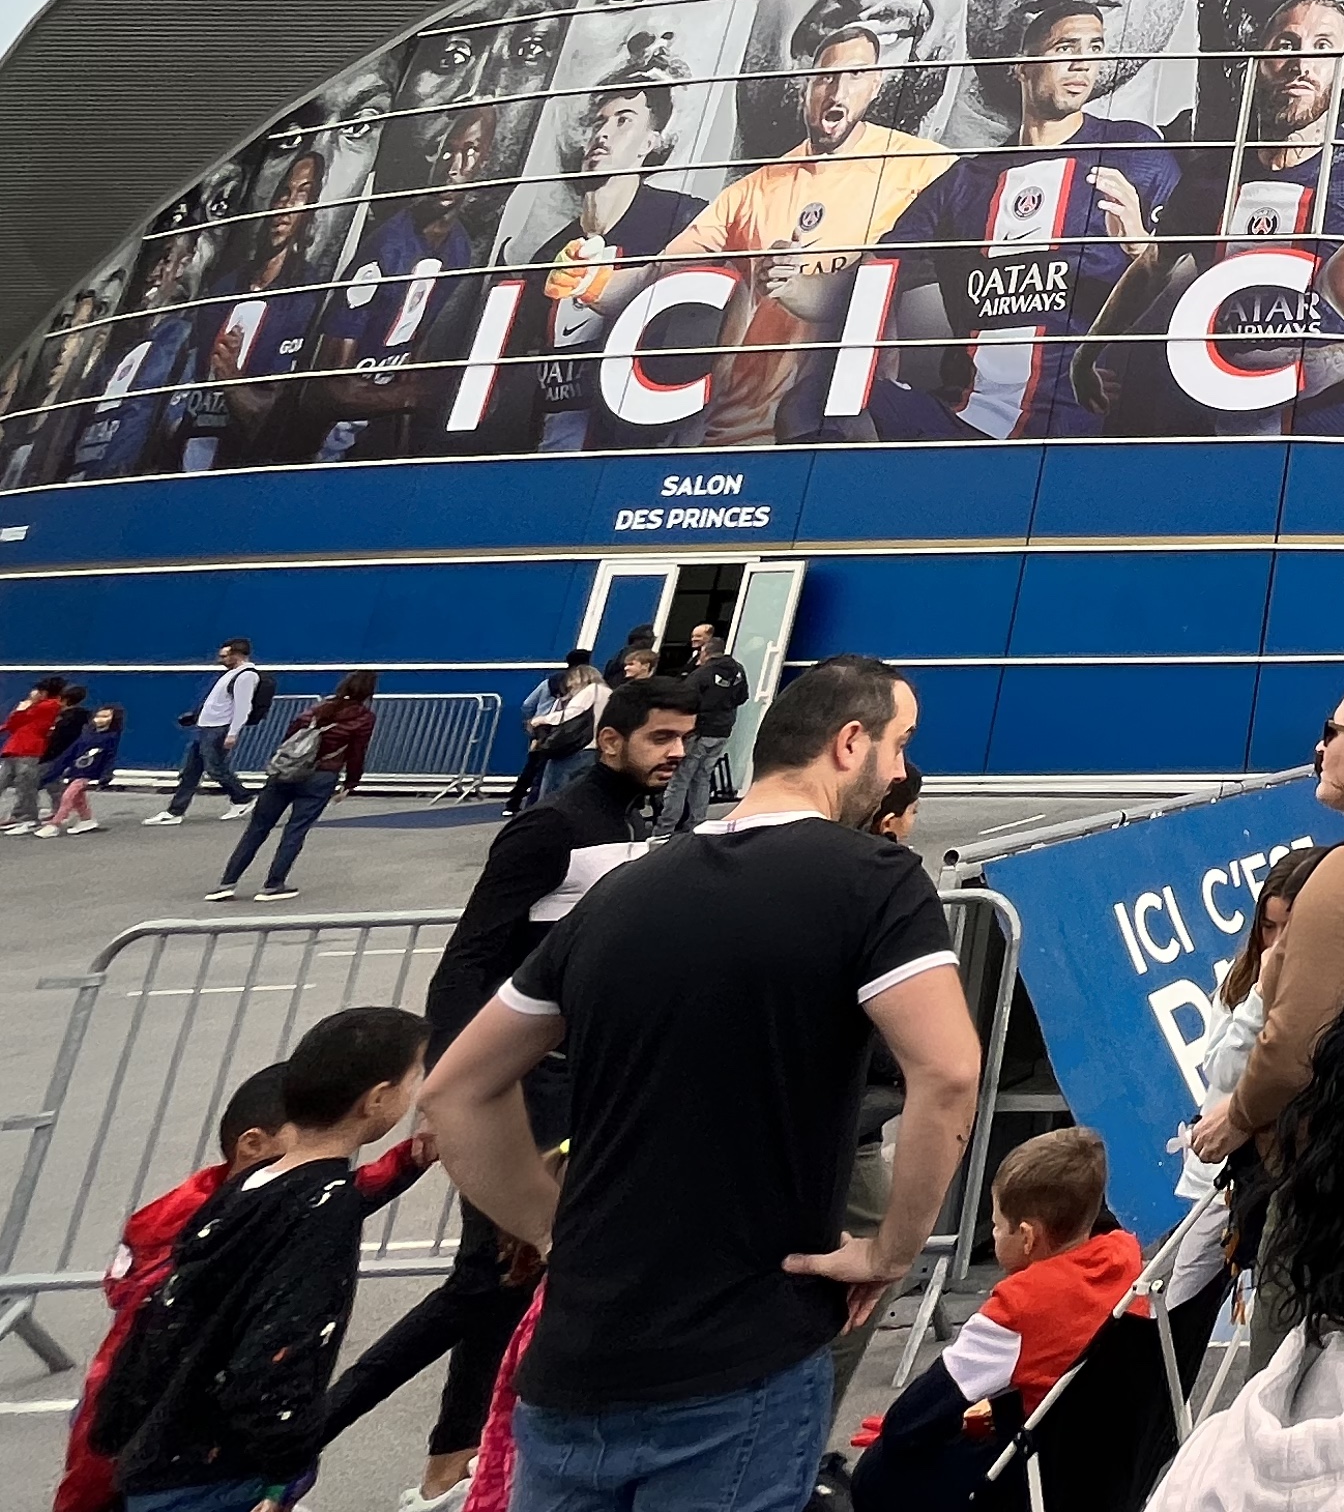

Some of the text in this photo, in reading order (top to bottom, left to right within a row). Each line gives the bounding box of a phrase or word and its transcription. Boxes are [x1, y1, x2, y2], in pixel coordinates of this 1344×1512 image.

[967, 261, 1069, 304] QATAR
[979, 291, 1067, 317] AIRWAYS
[1225, 292, 1321, 323] ATAR
[446, 259, 898, 431] ICI
[661, 474, 743, 497] SALON
[614, 505, 770, 532] DES PRINCES
[1113, 836, 1315, 975] ICI C'E
